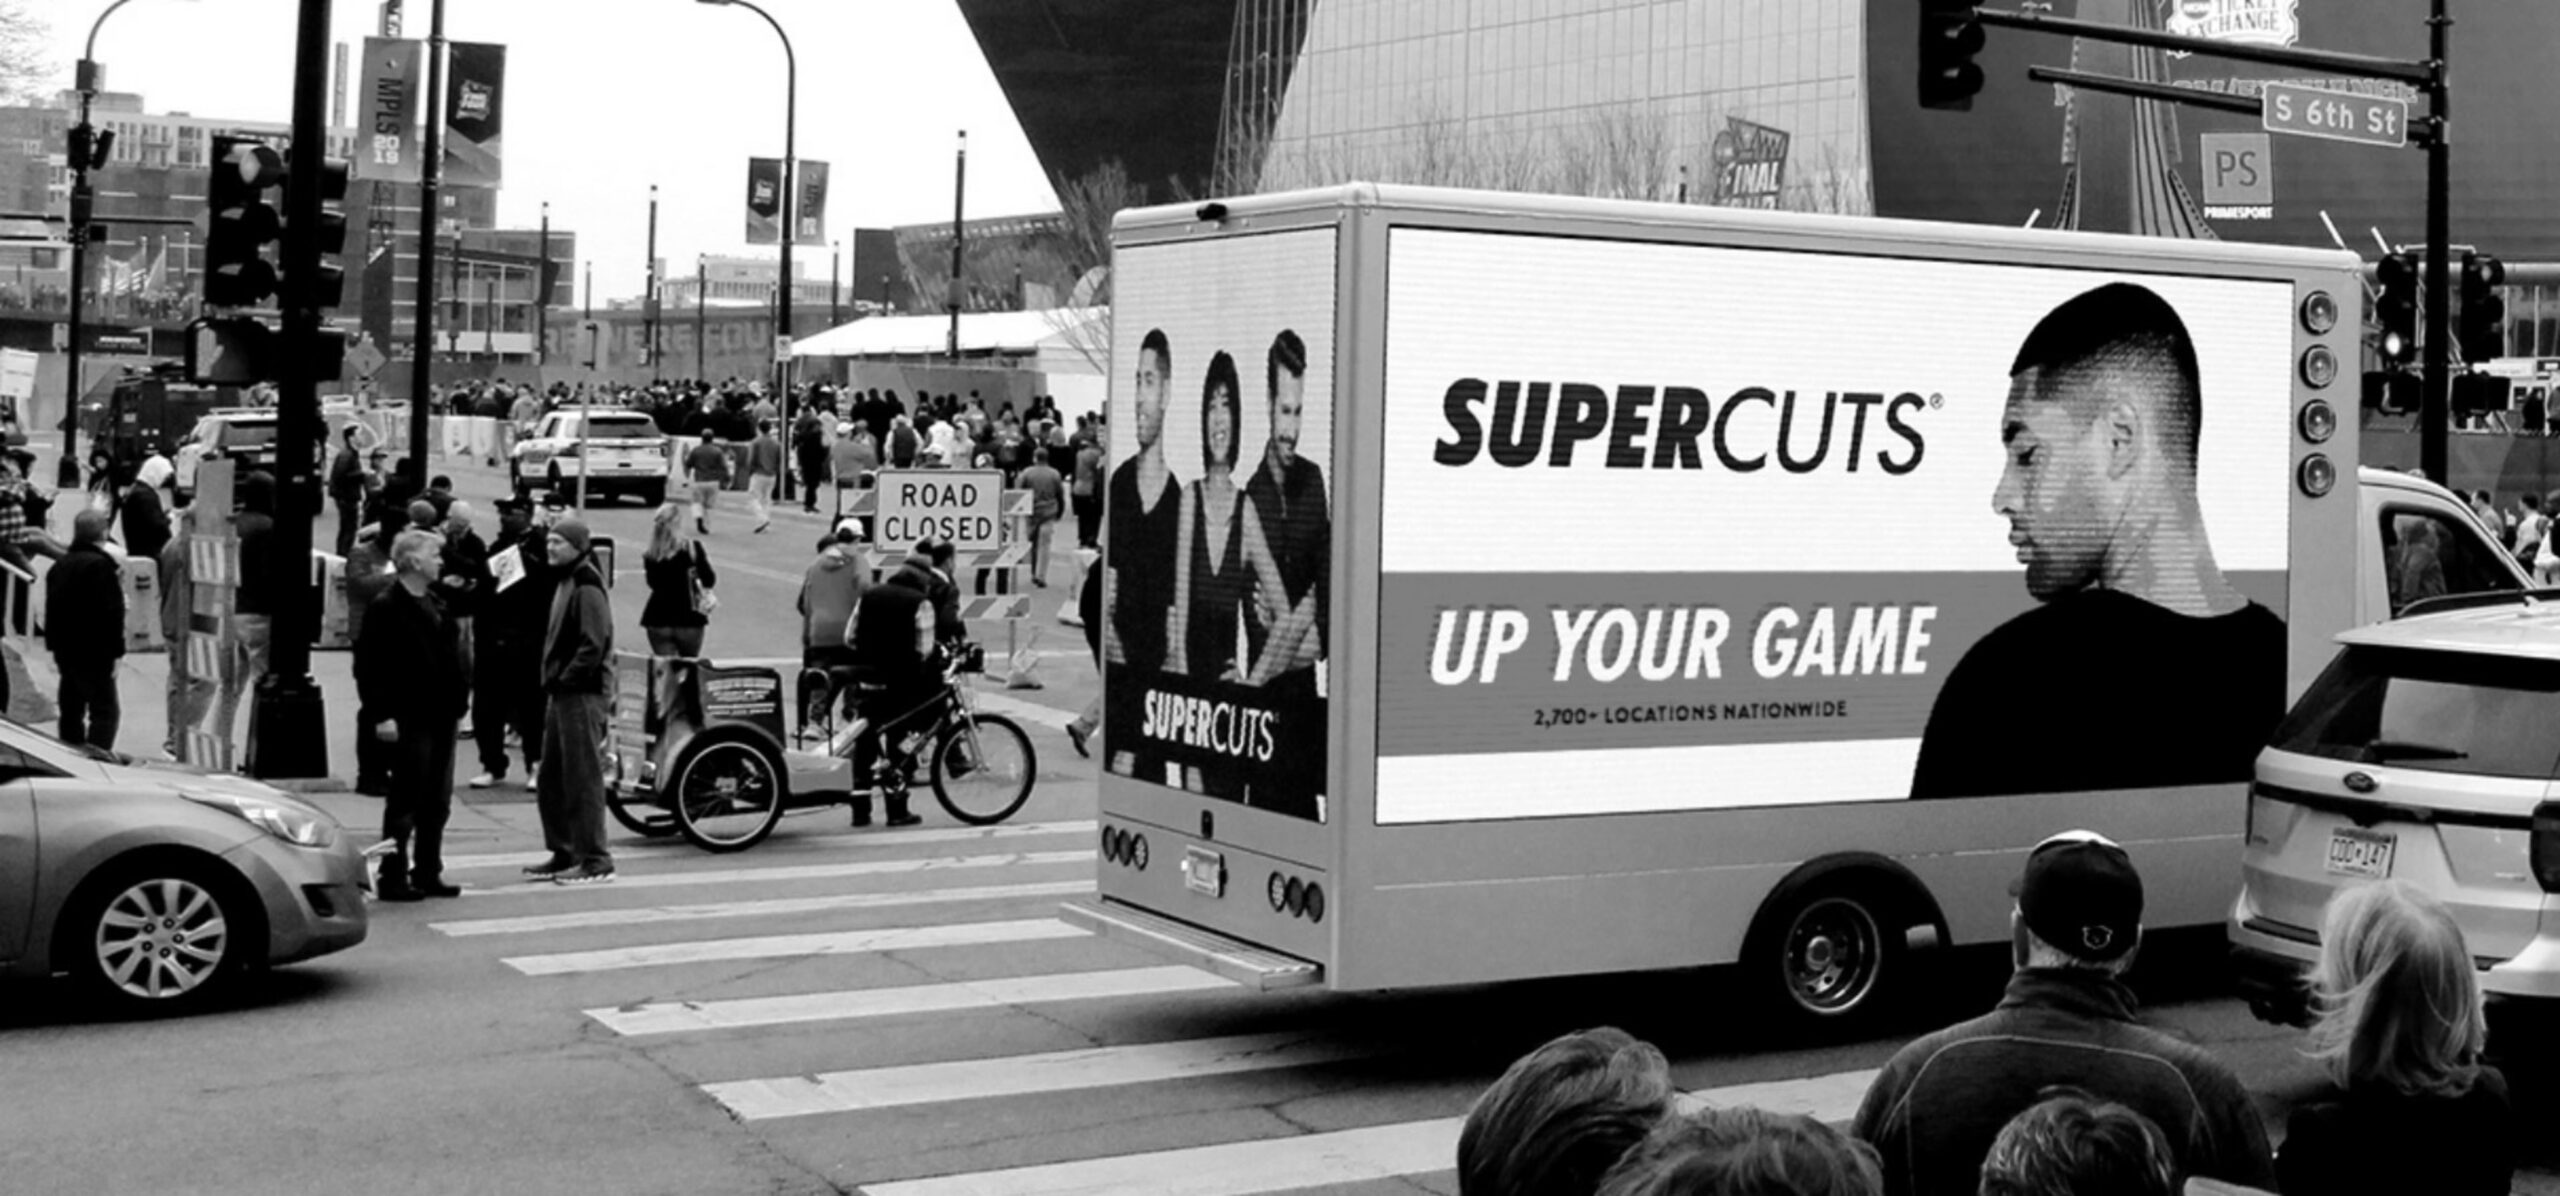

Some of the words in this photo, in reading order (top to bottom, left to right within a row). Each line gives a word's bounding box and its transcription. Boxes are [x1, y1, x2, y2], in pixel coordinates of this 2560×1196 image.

[375, 77, 403, 135] MPLS
[2275, 94, 2293, 121] S
[2306, 100, 2354, 129] 6th
[2367, 107, 2397, 135] St
[1719, 161, 1780, 197] FINAL
[2215, 150, 2258, 188] PS
[2203, 206, 2273, 219] PRIMESPORT
[902, 484, 977, 507] ROAD
[885, 516, 992, 541] CLOSED
[1430, 609, 1529, 685] UP
[1551, 607, 1731, 682] YOUR
[1751, 606, 1938, 679] GAME
[1143, 689, 1273, 761] SUPERCUTS
[1534, 708, 1598, 729] 2,700+
[1604, 703, 1717, 724] LOCATIONS
[1723, 699, 1848, 720] NATIONWIDE
